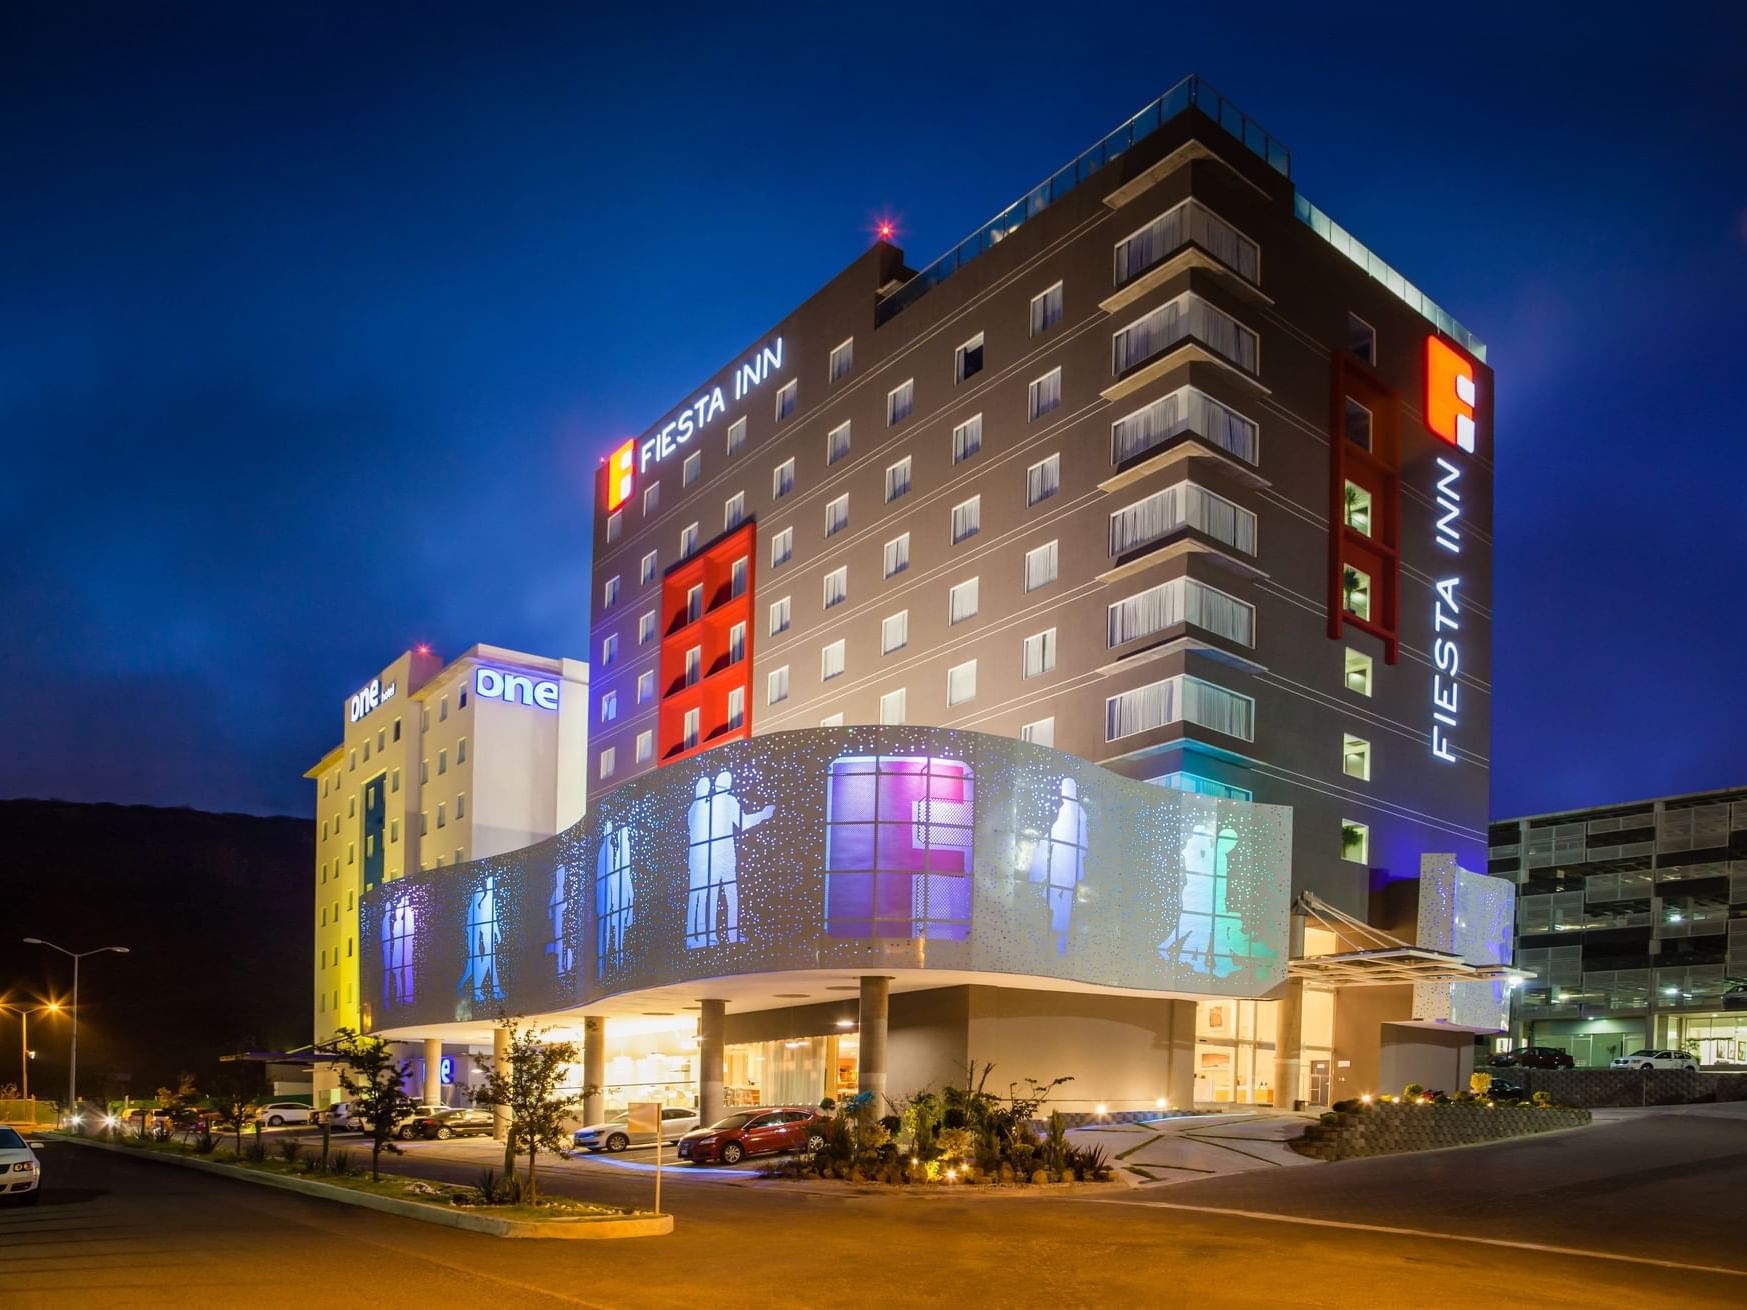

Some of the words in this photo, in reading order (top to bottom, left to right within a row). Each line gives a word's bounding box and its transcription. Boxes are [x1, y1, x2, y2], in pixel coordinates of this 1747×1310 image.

[641, 387, 725, 474] FIESTA
[736, 336, 782, 400] INN
[1436, 457, 1460, 553] INN
[351, 679, 379, 722] one
[476, 668, 559, 710] one
[1432, 577, 1460, 763] FIESTA
